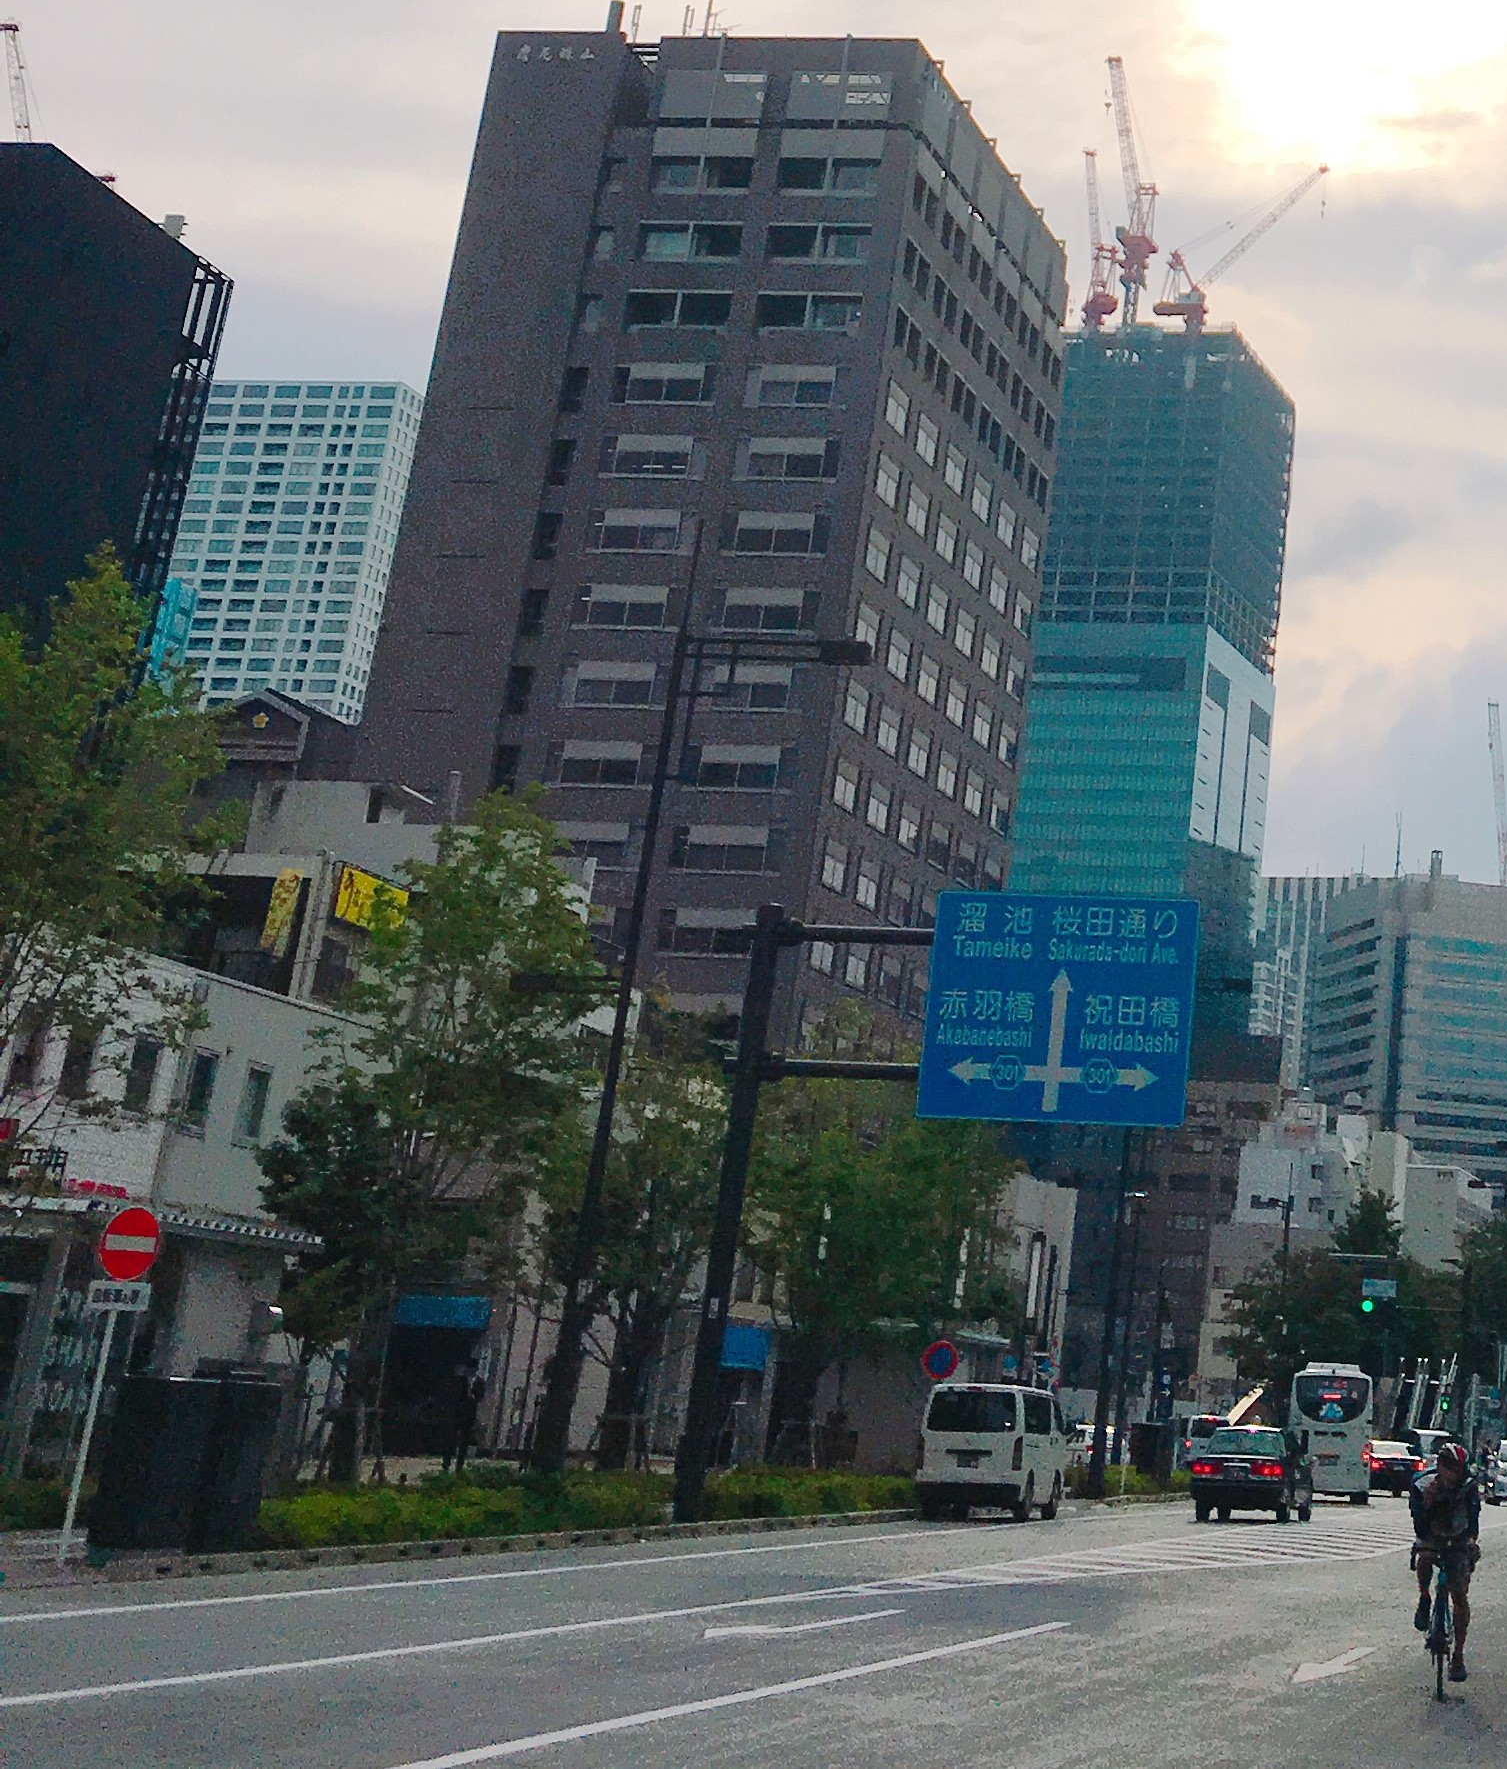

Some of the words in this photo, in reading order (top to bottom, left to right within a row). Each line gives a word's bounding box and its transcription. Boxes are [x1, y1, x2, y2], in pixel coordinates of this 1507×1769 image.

[957, 902, 1033, 934] 溜池
[1052, 906, 1178, 939] 桜田通り
[952, 934, 1033, 960] Tameike
[1048, 937, 1148, 964] Sakurada-dori
[939, 988, 1035, 1023] 赤羽橋
[1084, 994, 1180, 1028] 祝田橋
[936, 1023, 1032, 1047] Akabanebashi
[1079, 1028, 1180, 1053] Iwaidabashi
[995, 1064, 1019, 1081] 301
